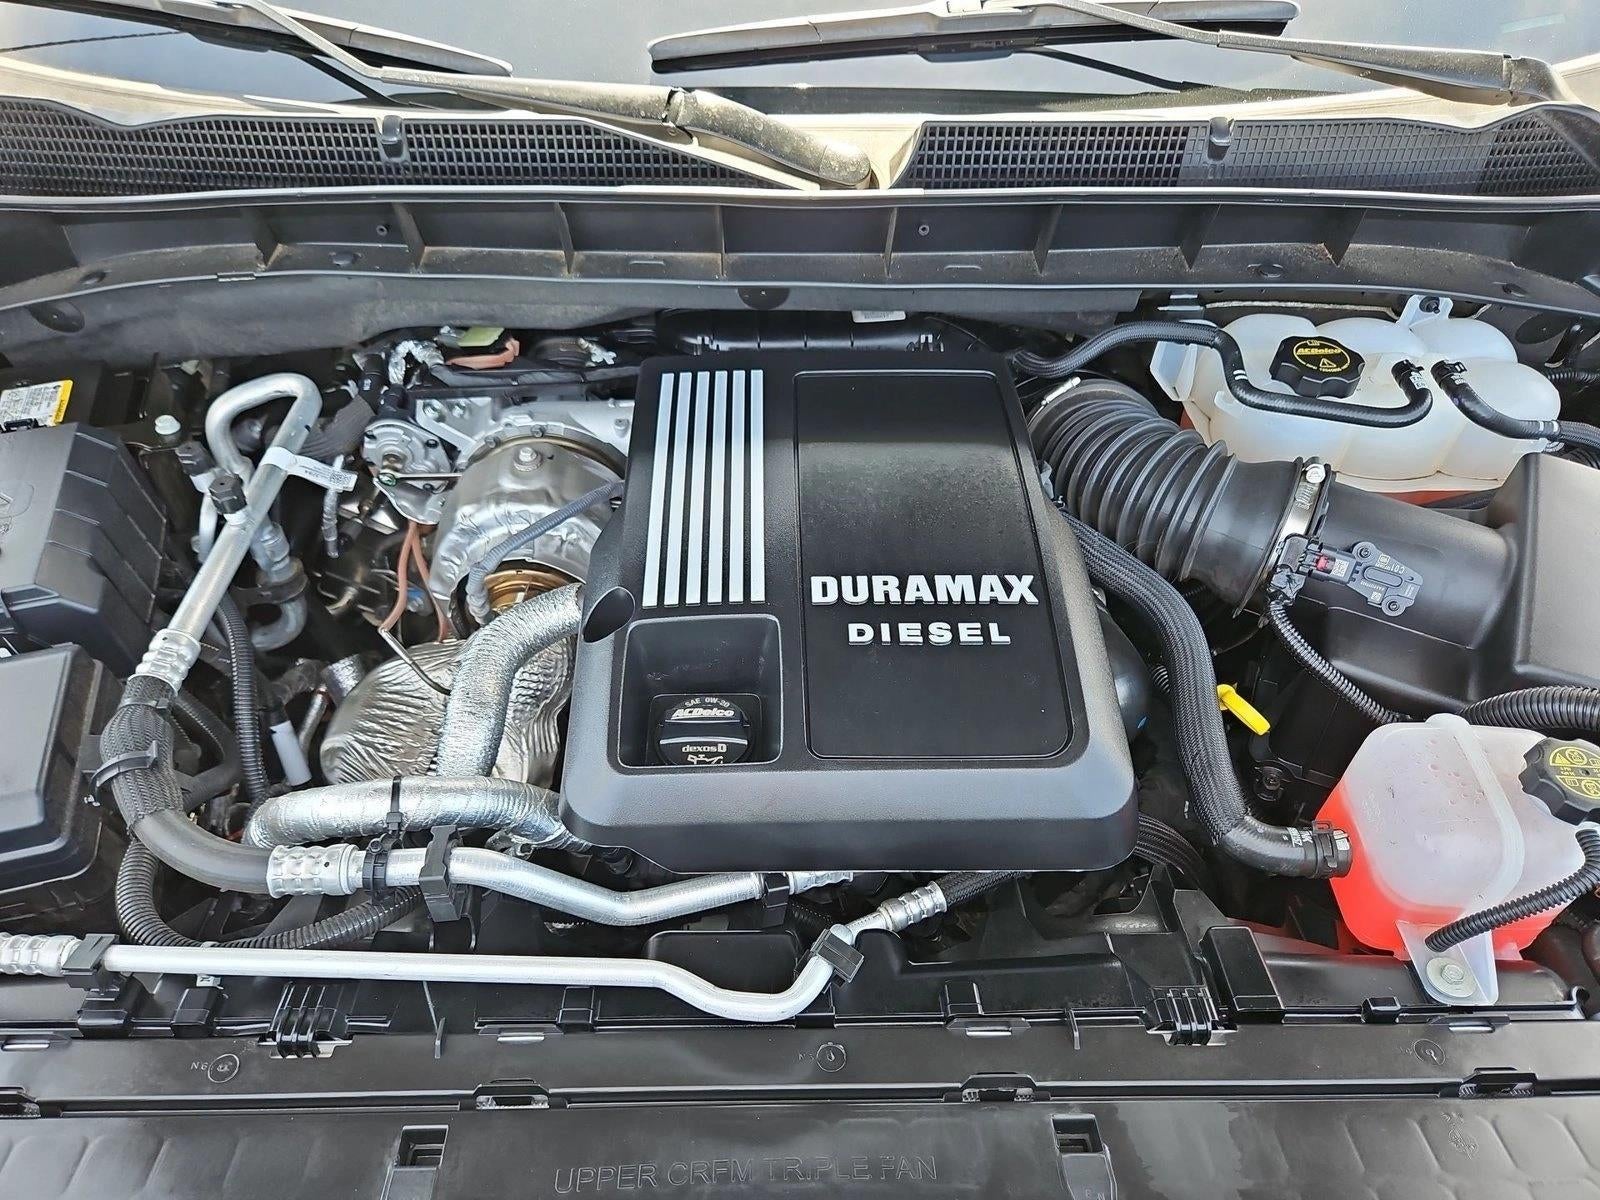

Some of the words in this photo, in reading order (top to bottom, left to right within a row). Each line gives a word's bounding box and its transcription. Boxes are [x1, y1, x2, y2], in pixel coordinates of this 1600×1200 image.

[810, 574, 1039, 605] DURAMAX
[848, 622, 1011, 645] DIESEL
[670, 707, 735, 720] ACDelco
[684, 698, 702, 708] SAE
[554, 1162, 659, 1194] UPPER
[667, 1158, 753, 1186] CRFM
[879, 1154, 938, 1181] FAN
